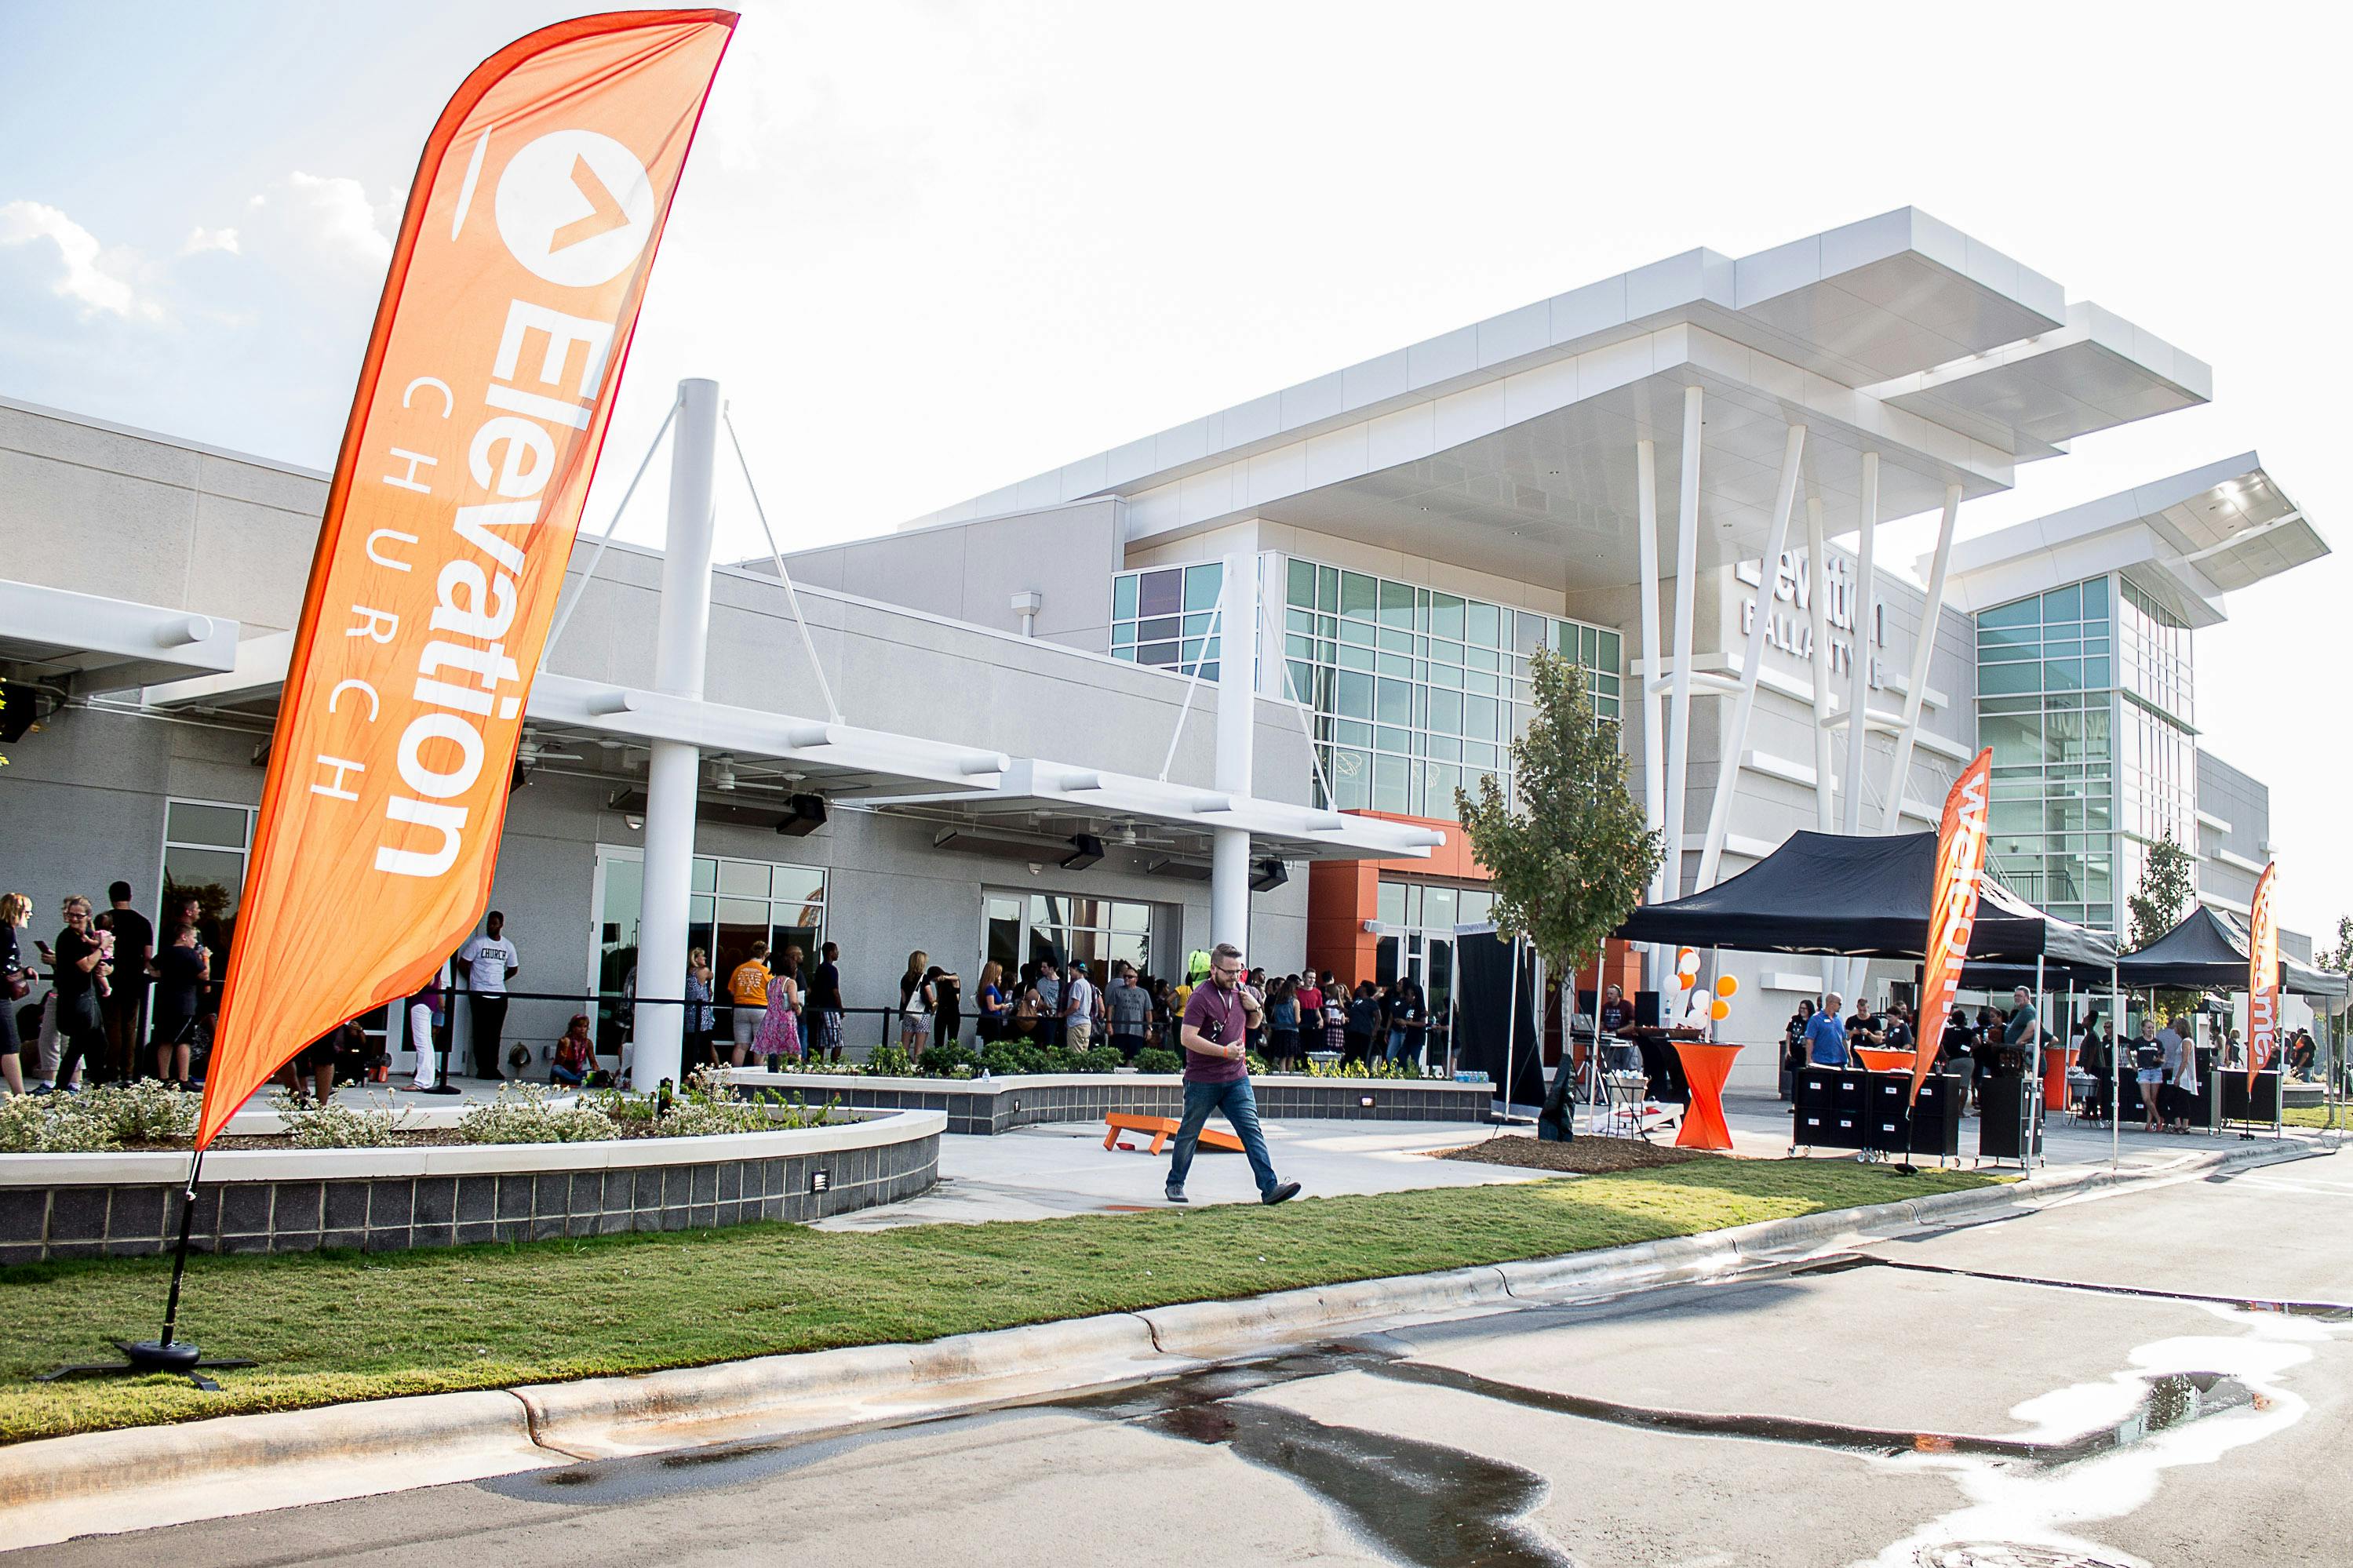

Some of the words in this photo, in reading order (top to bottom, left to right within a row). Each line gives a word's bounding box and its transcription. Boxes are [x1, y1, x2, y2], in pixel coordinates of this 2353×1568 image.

[309, 375, 454, 804] CHURCH
[373, 297, 617, 879] Elevation
[1735, 549, 1888, 648] evtin
[480, 948, 507, 961] CHURCH
